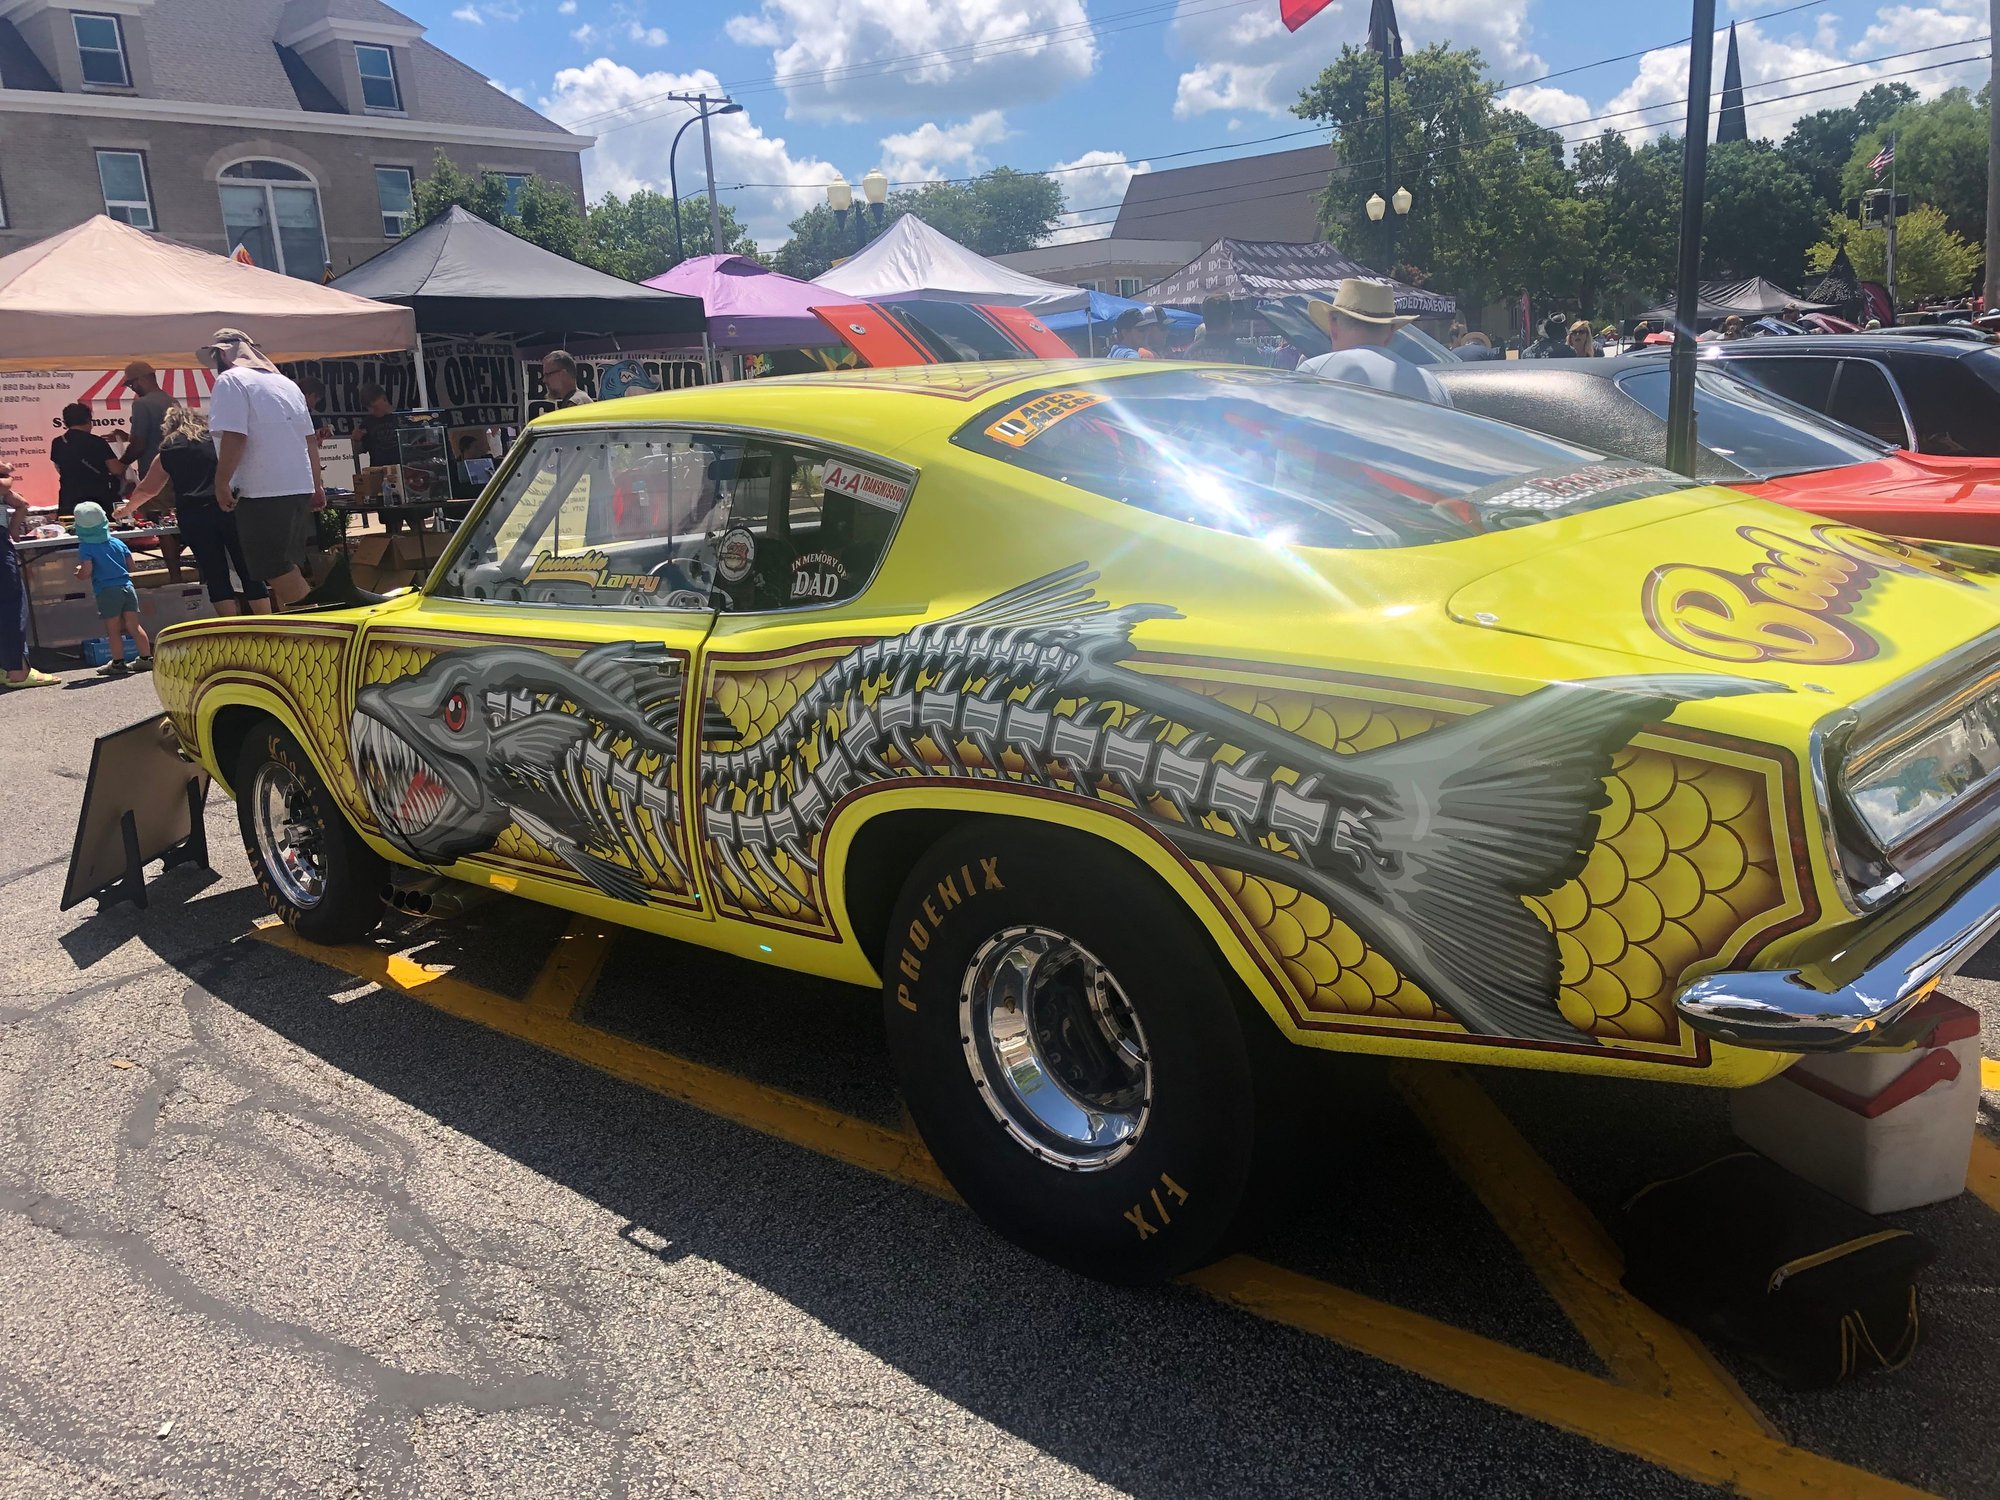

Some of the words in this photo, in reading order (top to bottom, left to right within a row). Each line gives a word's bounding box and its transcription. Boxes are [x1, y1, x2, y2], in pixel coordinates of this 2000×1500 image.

[1241, 274, 1296, 290] DIRTY
[1396, 296, 1456, 313] NDEDTAKEOVER
[2, 383, 18, 391] BBQ
[19, 383, 36, 392] Baby
[56, 382, 71, 390] Ribs
[52, 371, 74, 379] County
[444, 355, 518, 407] OPEN!
[20, 447, 46, 455] Picnics
[791, 557, 802, 572] IN
[802, 553, 838, 567] MEMORY
[836, 562, 848, 578] OF
[596, 569, 661, 593] Larry
[793, 571, 839, 598] DAD
[1641, 524, 1881, 665] Bad
[897, 856, 1005, 1012] PHOENIX
[1123, 1172, 1189, 1240] F/X
